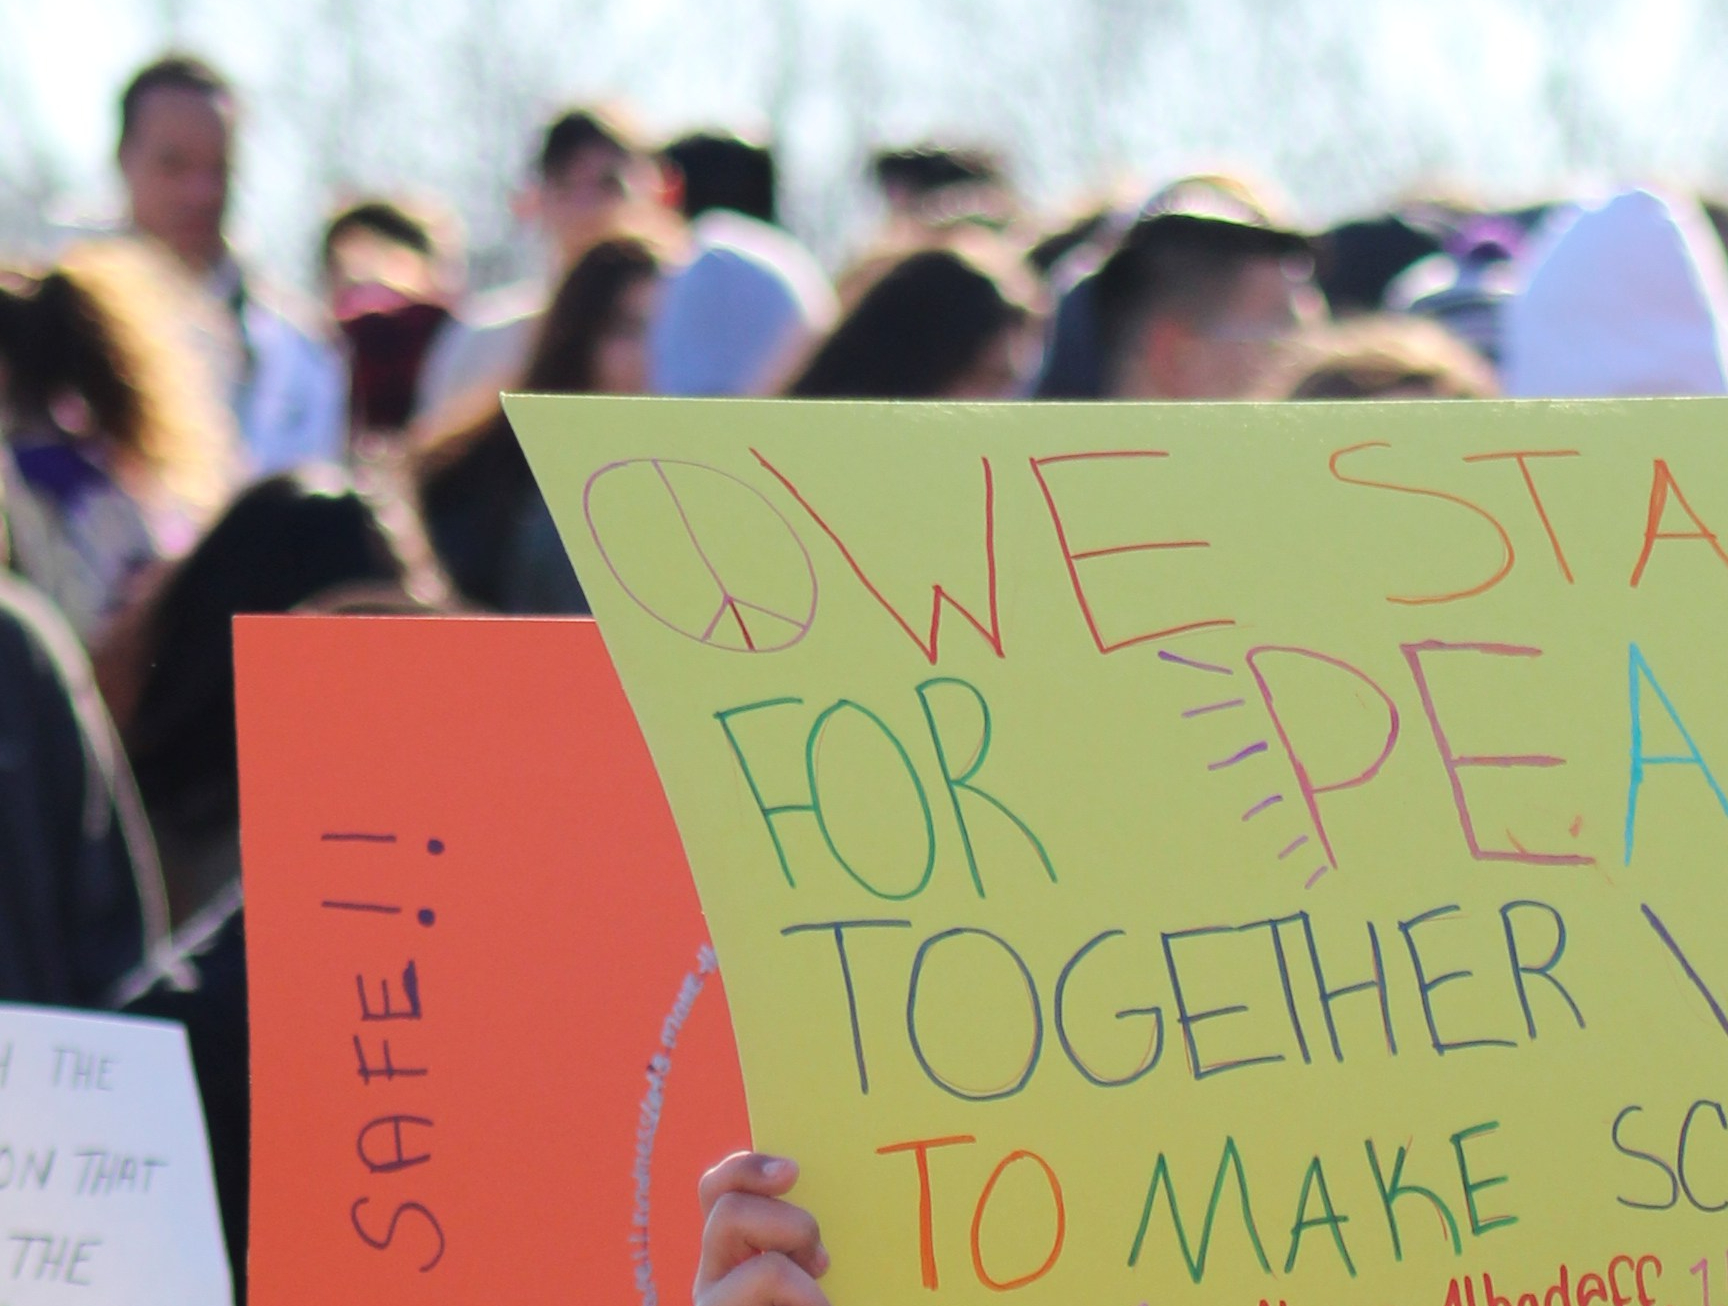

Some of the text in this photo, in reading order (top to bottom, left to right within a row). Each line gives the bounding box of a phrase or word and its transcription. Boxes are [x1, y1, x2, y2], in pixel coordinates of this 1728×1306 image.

[749, 447, 1236, 664] WE
[715, 677, 1057, 900] FOR
[53, 1047, 118, 1090] THE
[320, 832, 447, 1273] SAFE!!
[781, 900, 1586, 1102] TOGETHER
[9, 1232, 104, 1285] THE
[75, 1150, 169, 1196] THAT
[876, 1134, 1067, 1292] TO
[1127, 1120, 1519, 1284] MAKE
